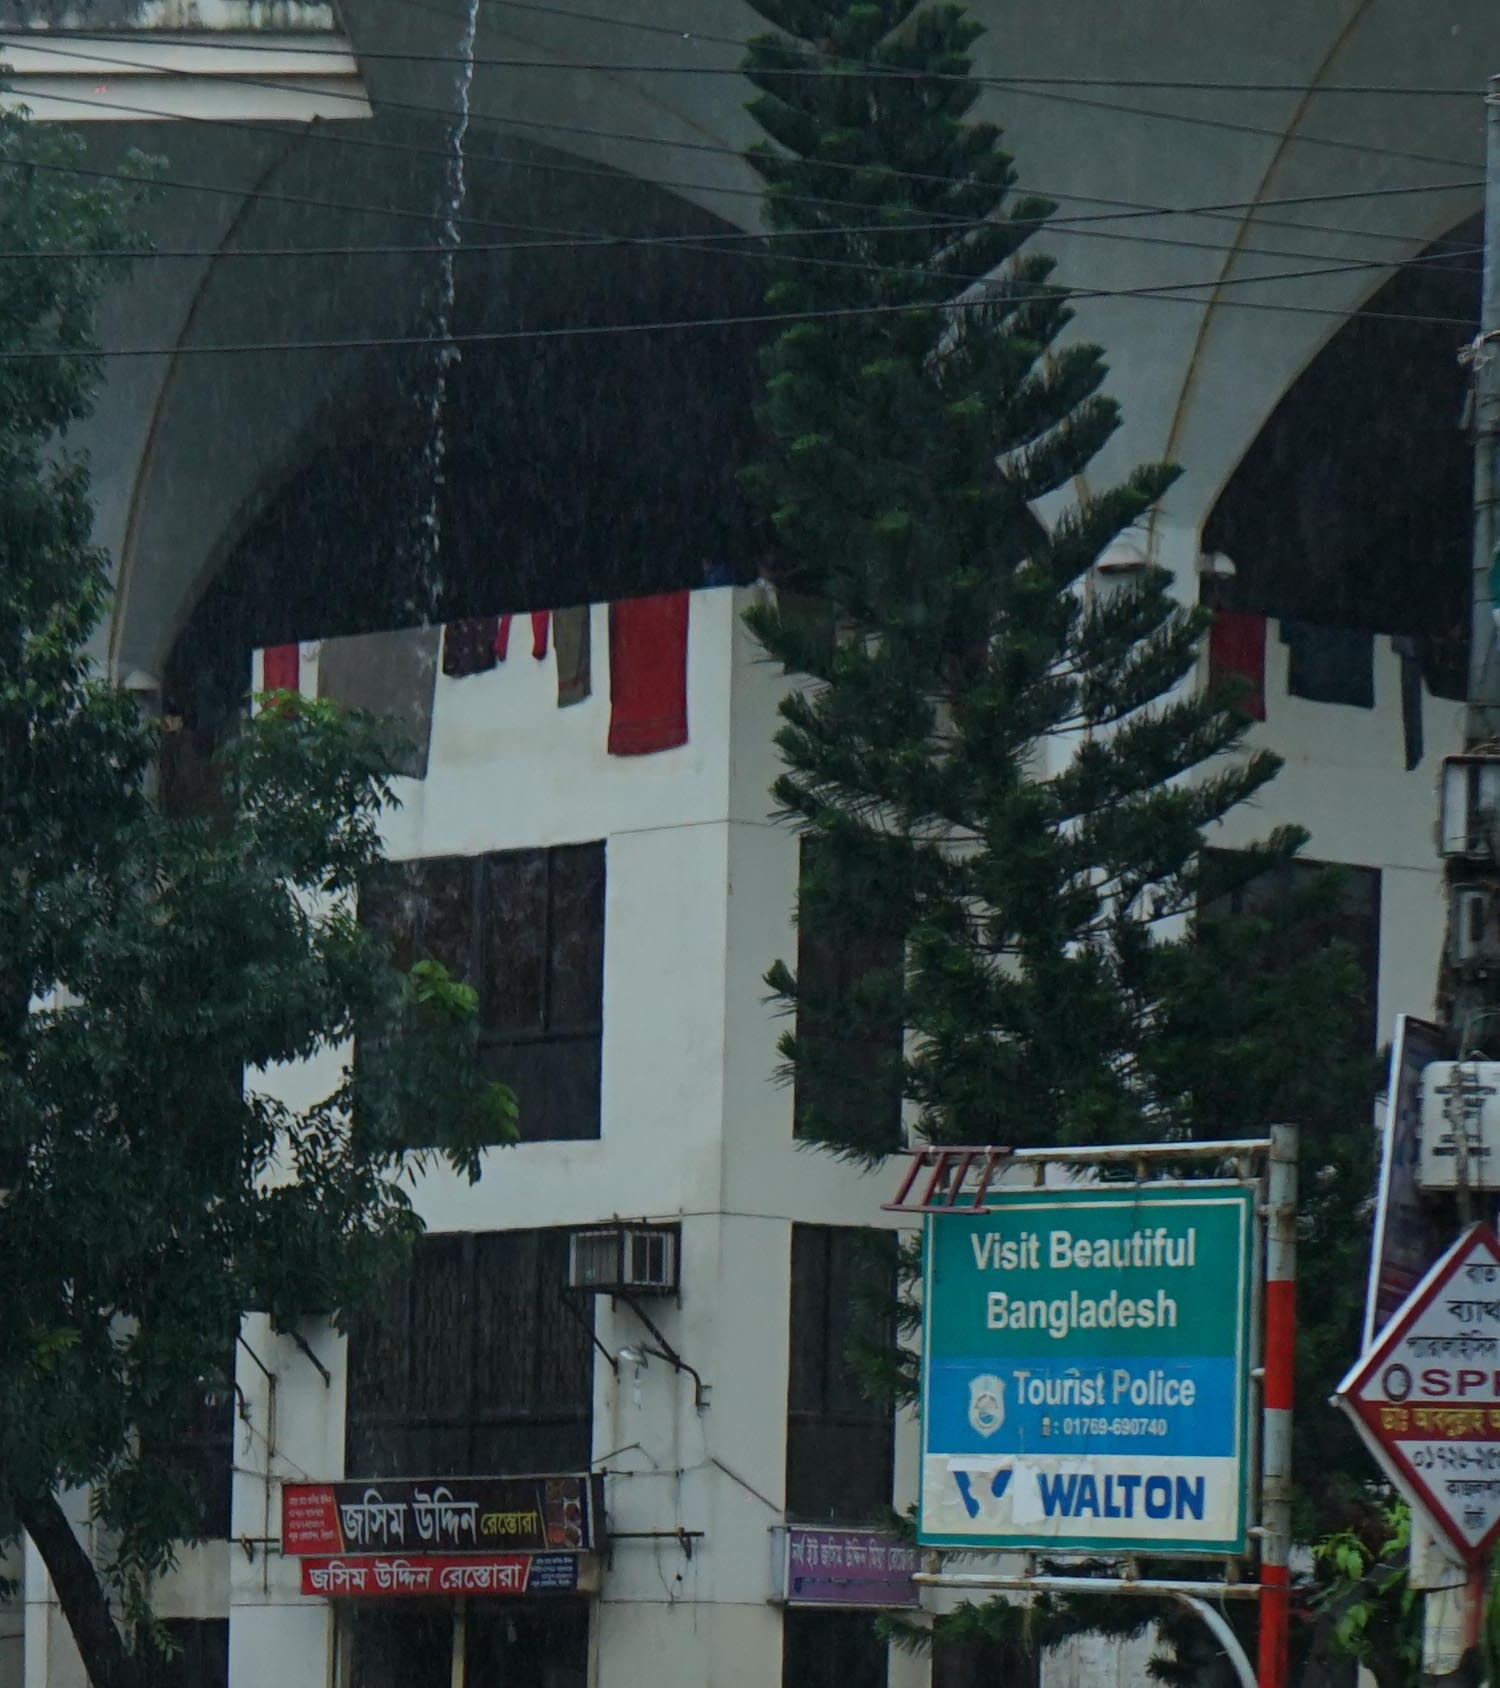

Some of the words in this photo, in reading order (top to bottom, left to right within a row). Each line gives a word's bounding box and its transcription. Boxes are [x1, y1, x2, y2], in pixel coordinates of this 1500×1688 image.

[971, 1231, 1040, 1270] Visit
[1049, 1227, 1197, 1269] Beautiful
[986, 1289, 1177, 1339] Bangladesh
[1012, 1369, 1105, 1405] Tourist
[1112, 1368, 1196, 1405] Police
[339, 1488, 407, 1544] জসিম
[411, 1487, 479, 1544] উদ্দিন
[1040, 1473, 1205, 1520] WALTON
[308, 1561, 370, 1591] জসিম
[372, 1559, 434, 1590] উদ্দিন
